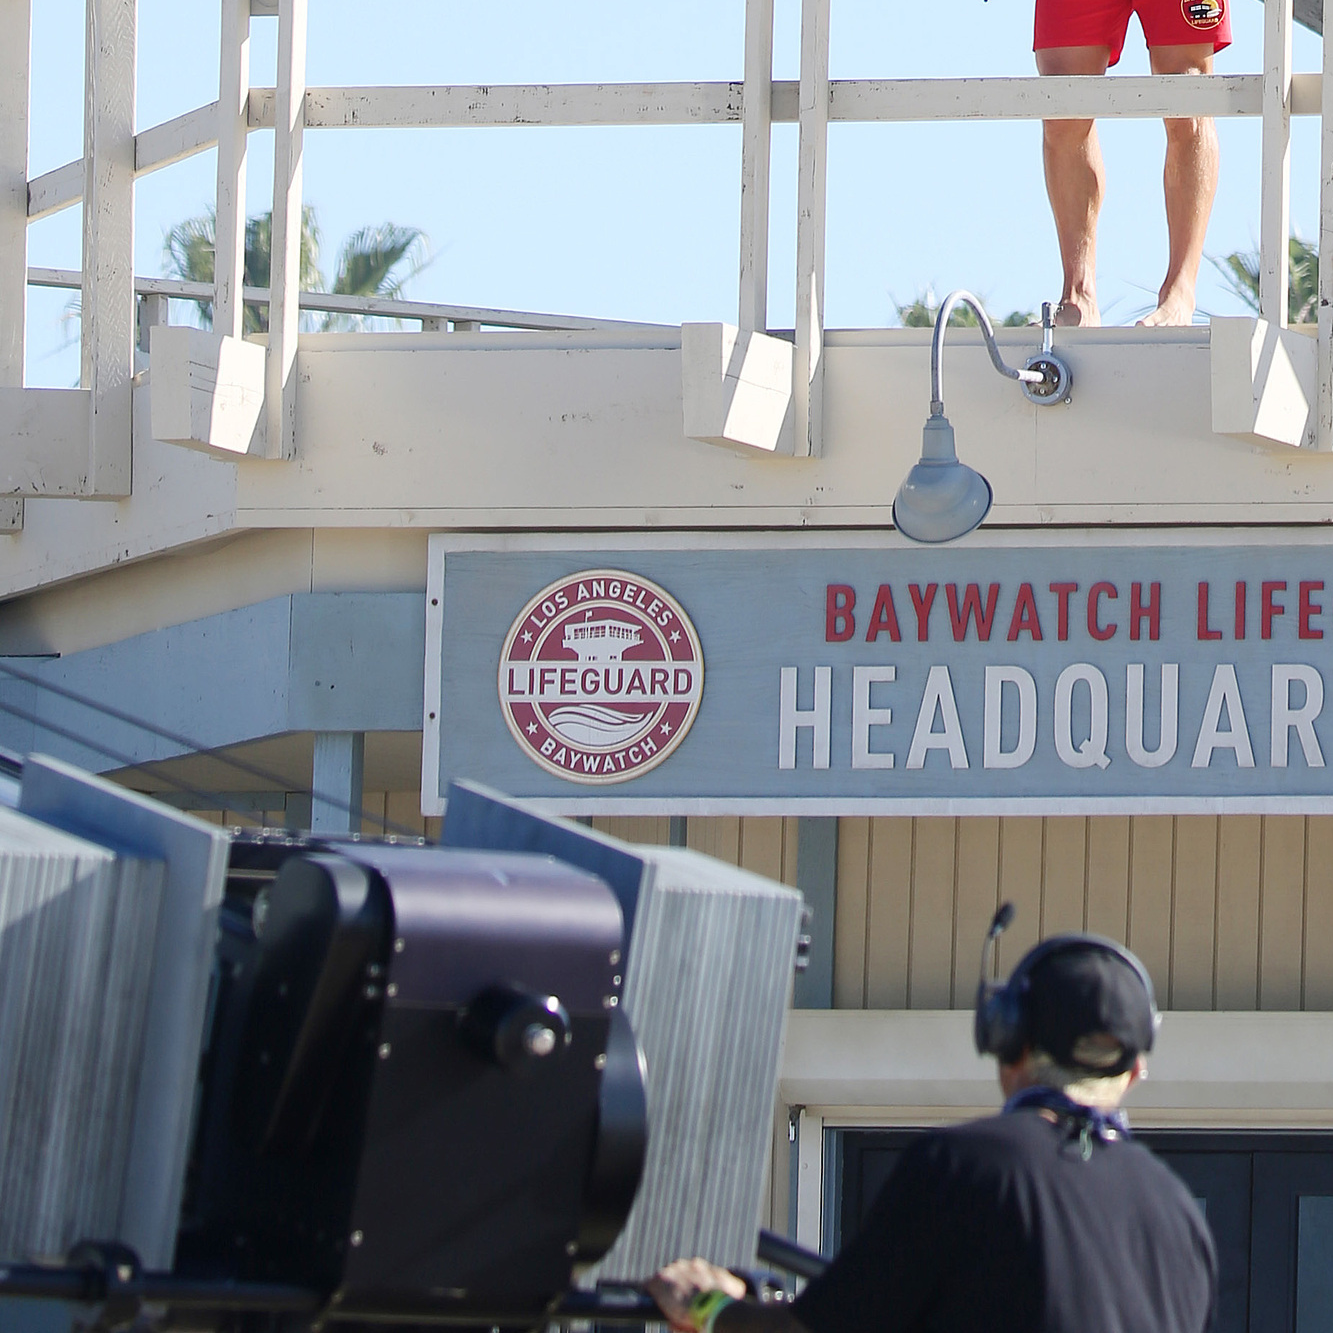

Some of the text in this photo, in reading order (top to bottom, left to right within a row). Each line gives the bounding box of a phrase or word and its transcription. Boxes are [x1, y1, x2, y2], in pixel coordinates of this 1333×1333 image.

[530, 580, 673, 628] LOS ANGELES
[825, 581, 1162, 643] BAYWATCH
[507, 668, 694, 696] LIFEGUARD
[540, 736, 658, 773] BAYWATCH
